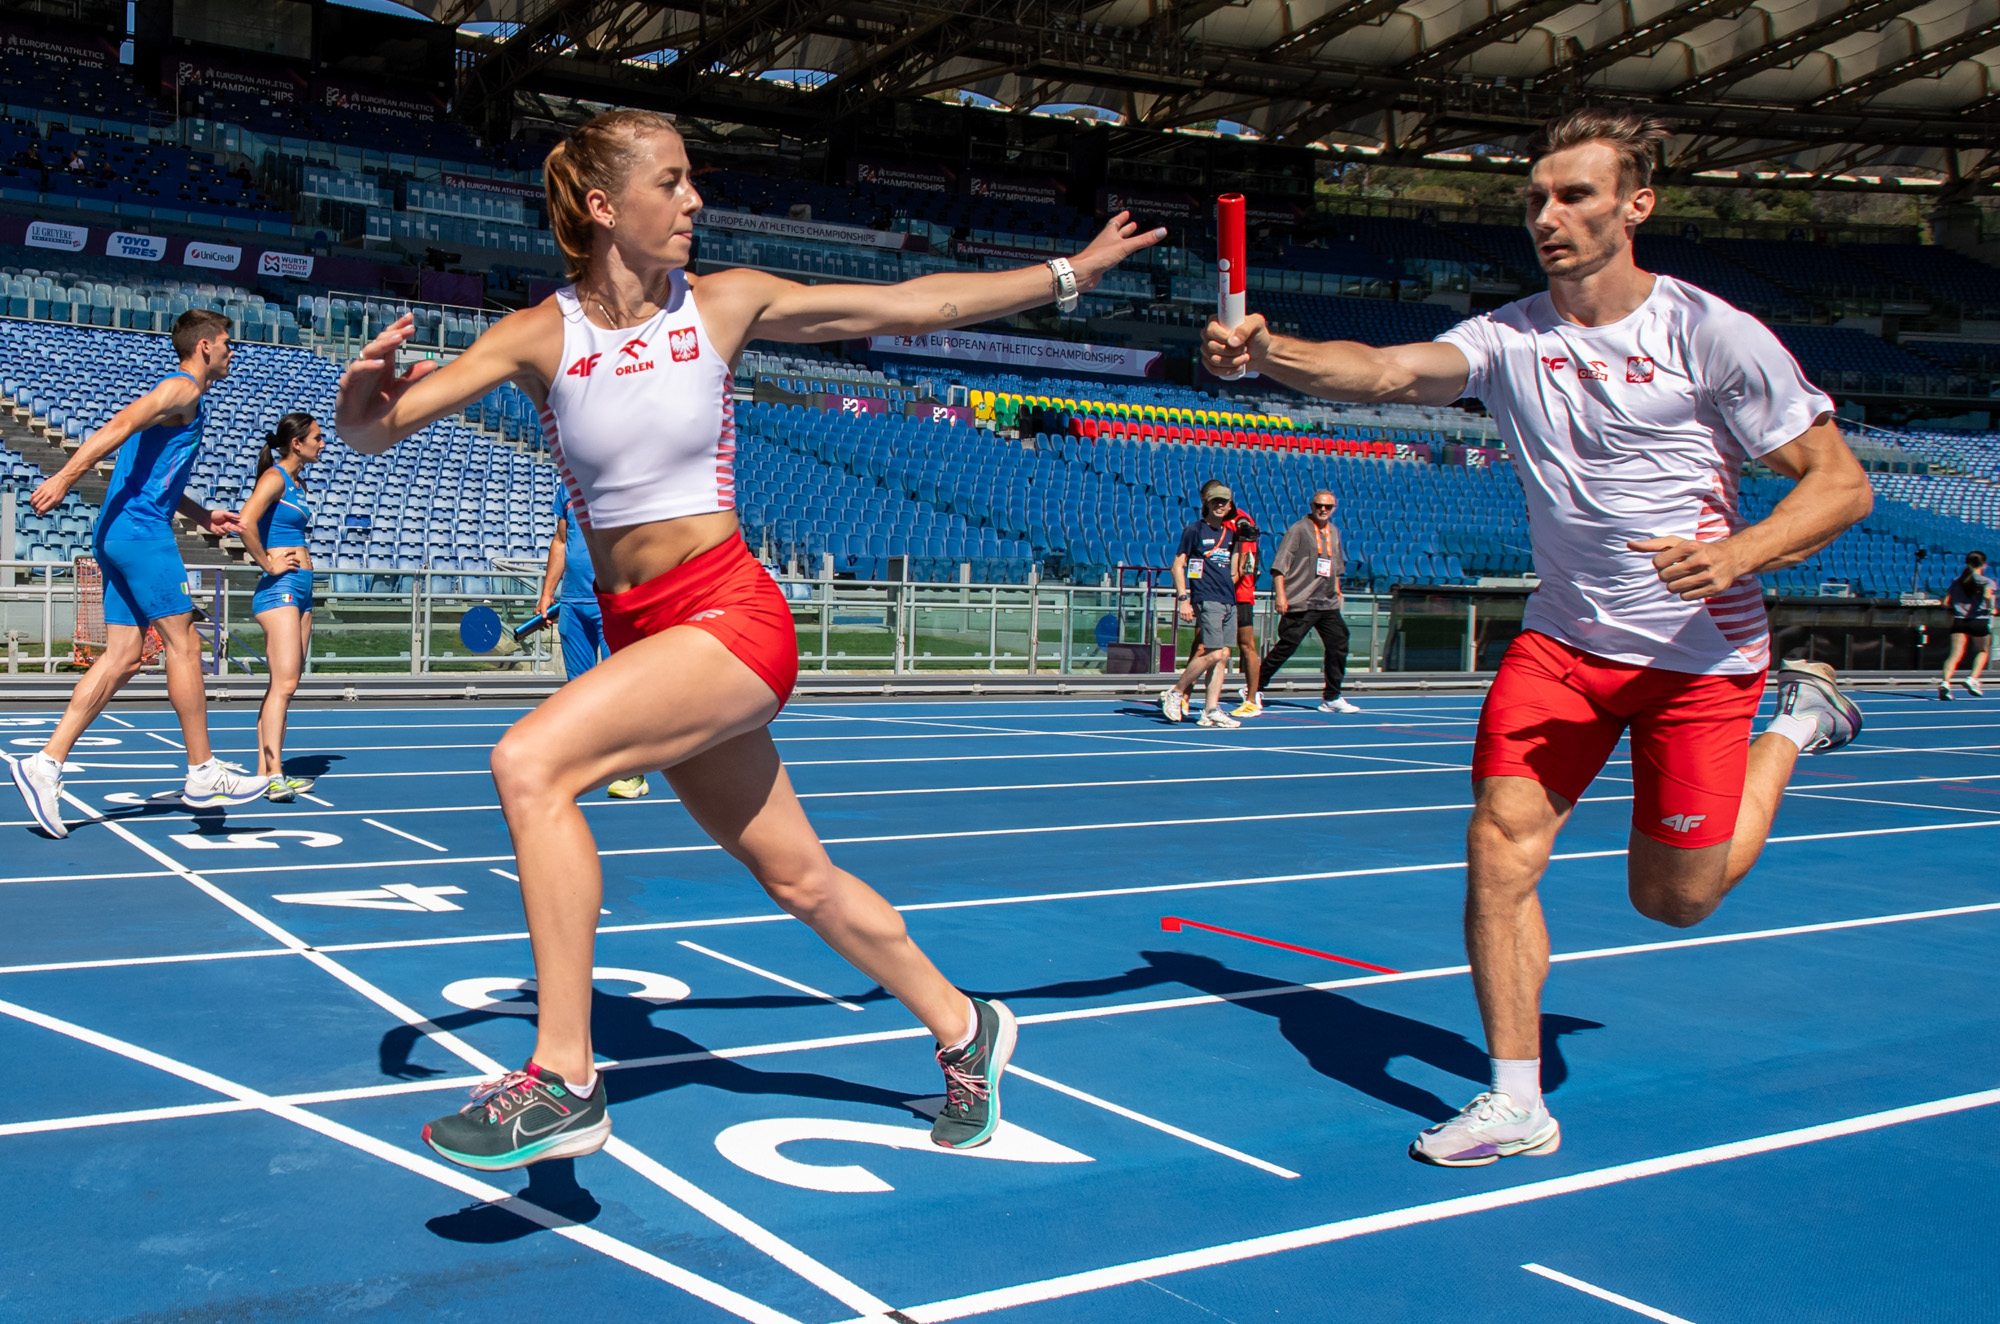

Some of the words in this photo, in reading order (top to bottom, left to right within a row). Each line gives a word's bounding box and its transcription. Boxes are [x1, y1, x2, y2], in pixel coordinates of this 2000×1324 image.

[20, 38, 62, 52] EUROPEAN
[63, 46, 105, 60] ATHLETICS
[215, 71, 255, 84] EUROPEAN
[360, 95, 398, 107] EUROPEAN
[399, 101, 434, 113] ATHLETICS
[886, 169, 915, 179] EUROPEAN
[466, 181, 501, 193] EUROPEAN
[502, 187, 535, 198] ATHLETICS
[878, 178, 946, 193] CHAMPIONSHIPS
[989, 191, 1056, 205] CHAMPIONSHIPS
[32, 226, 41, 236] LE
[709, 214, 757, 229] EUROPEAN
[759, 221, 805, 235] ATHLETICS
[806, 227, 876, 243] CHAMPIONSHIPS
[117, 235, 150, 248] TOYO
[121, 245, 158, 258] TIRES
[200, 251, 235, 264] UniCredit
[281, 263, 308, 271] MODYF
[930, 335, 986, 352] EUROPEAN
[989, 341, 1044, 357] ATHLETICS
[1045, 345, 1126, 365] CHAMPIONSHIPS
[566, 352, 603, 378] 4F
[615, 360, 655, 376] ORLEN
[1660, 813, 1707, 833] 4F
[168, 829, 343, 850] 5
[271, 882, 469, 913] 4
[713, 1097, 1097, 1194] 2
